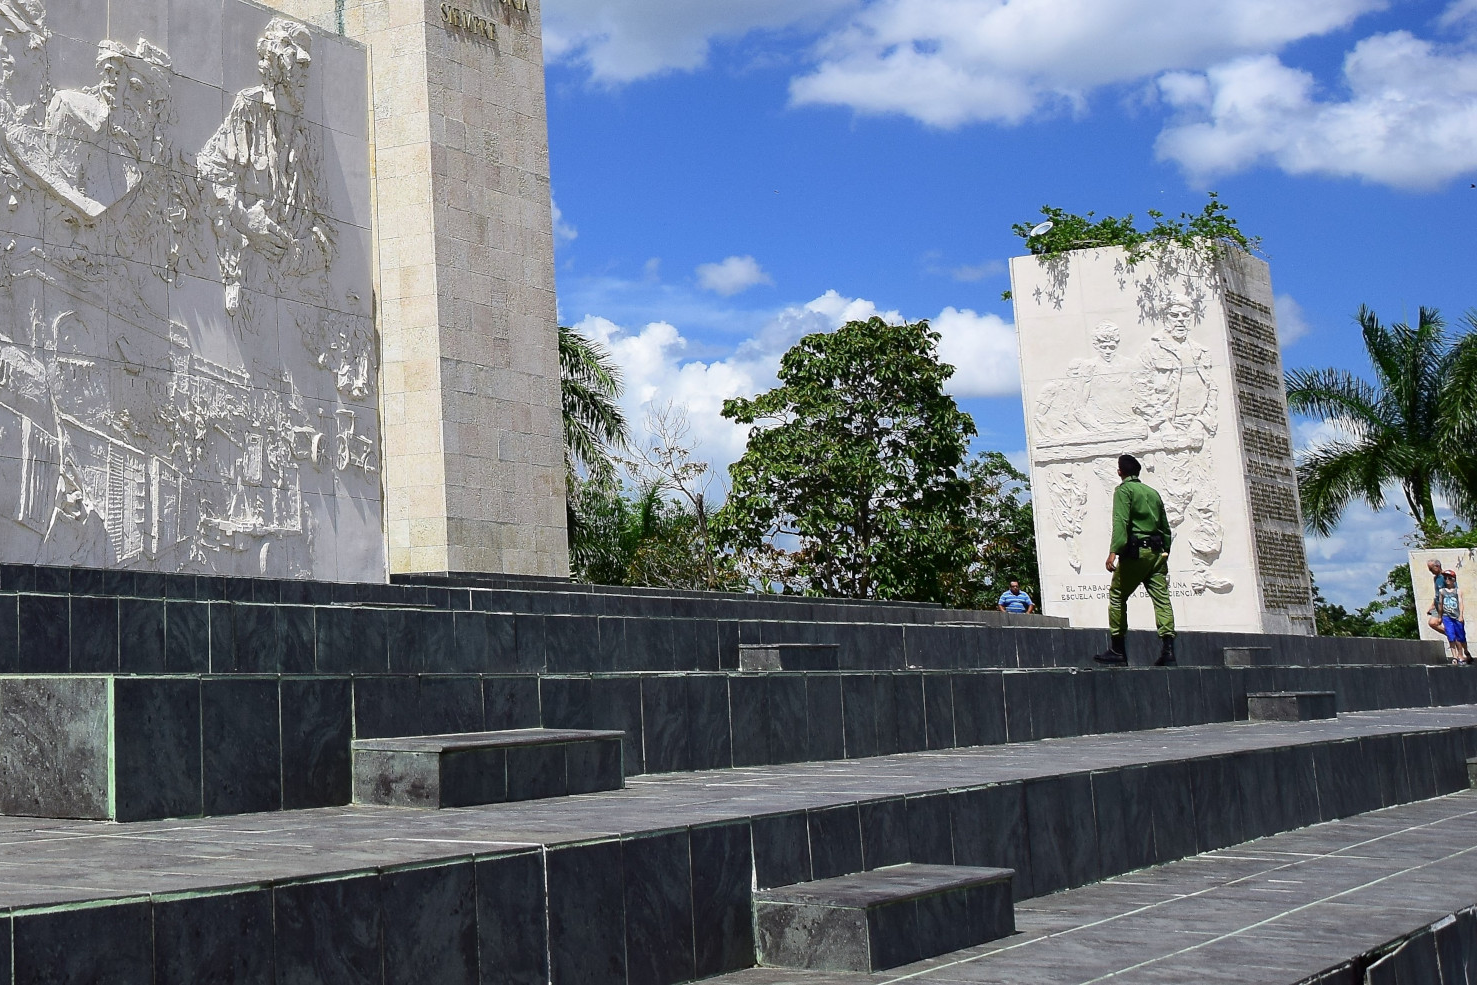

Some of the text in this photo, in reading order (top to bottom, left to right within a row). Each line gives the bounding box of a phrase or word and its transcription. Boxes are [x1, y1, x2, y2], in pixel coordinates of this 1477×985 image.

[440, 2, 496, 41] SIEMPRE
[1172, 581, 1187, 589] UNA
[1061, 592, 1093, 601] ESCUELA
